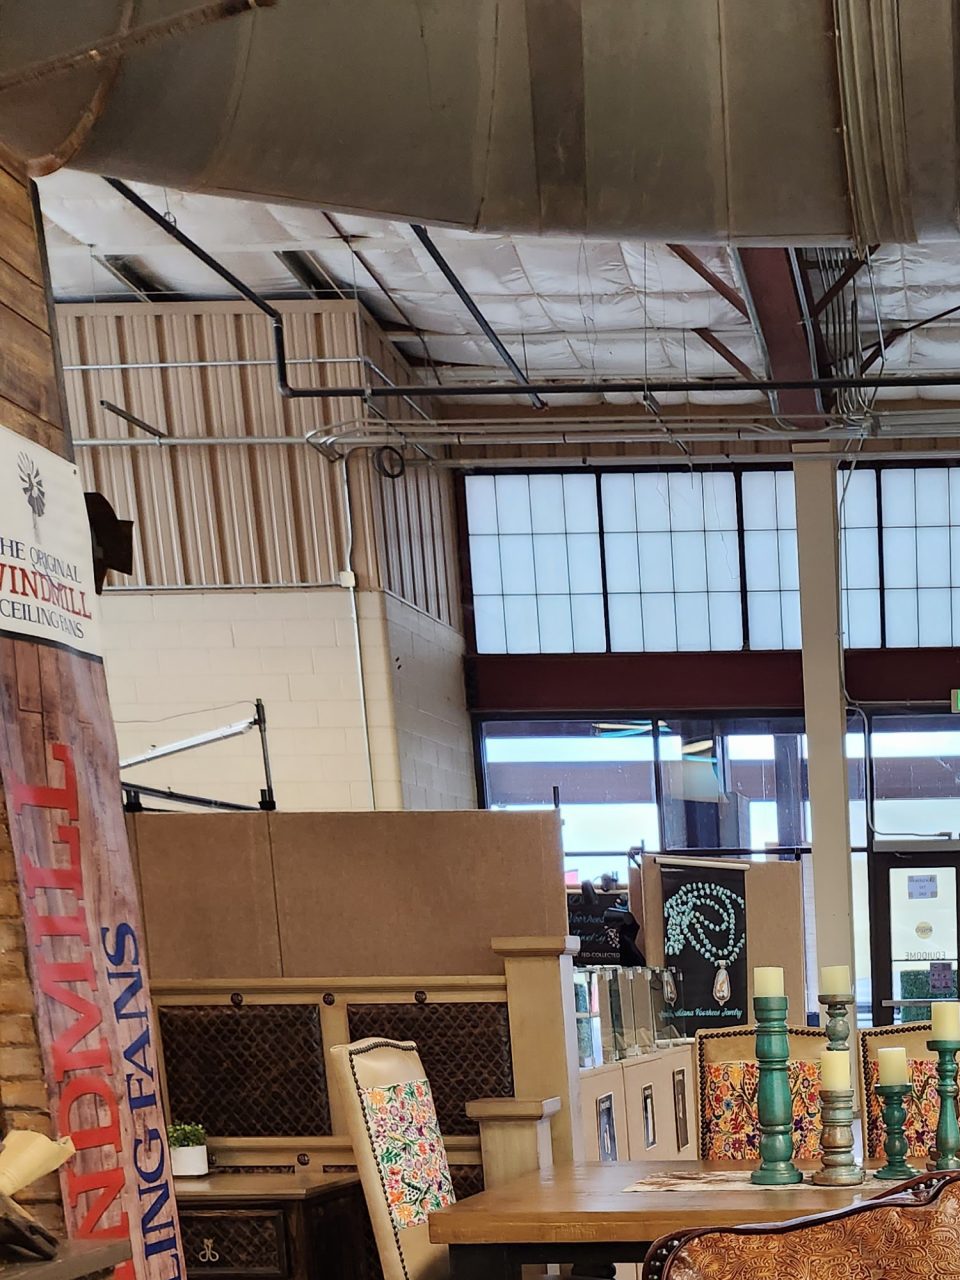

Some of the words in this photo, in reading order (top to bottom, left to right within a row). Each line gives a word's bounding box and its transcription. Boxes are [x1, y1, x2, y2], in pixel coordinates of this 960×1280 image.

[0, 537, 26, 561] HE
[30, 546, 82, 584] ORIGINAL
[0, 598, 59, 629] CEILING
[58, 614, 84, 639] FANS
[101, 922, 158, 1115] FANS
